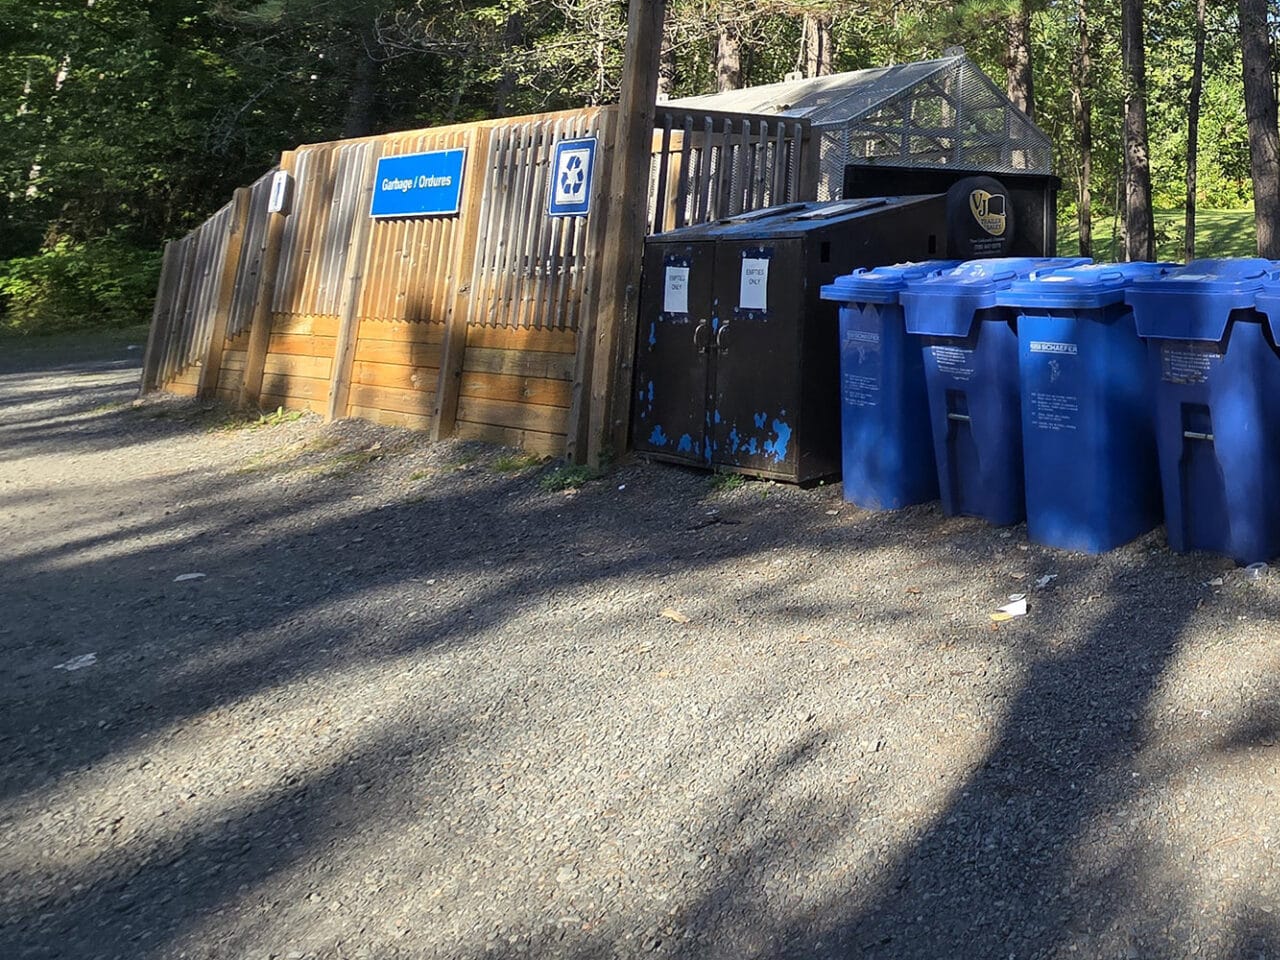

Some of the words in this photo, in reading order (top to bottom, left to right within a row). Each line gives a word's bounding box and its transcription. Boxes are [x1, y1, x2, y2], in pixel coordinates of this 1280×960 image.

[382, 178, 413, 193] Garbage
[418, 175, 452, 188] Ordures
[748, 278, 761, 286] ONLY
[1042, 343, 1078, 353] SCHAEFER
